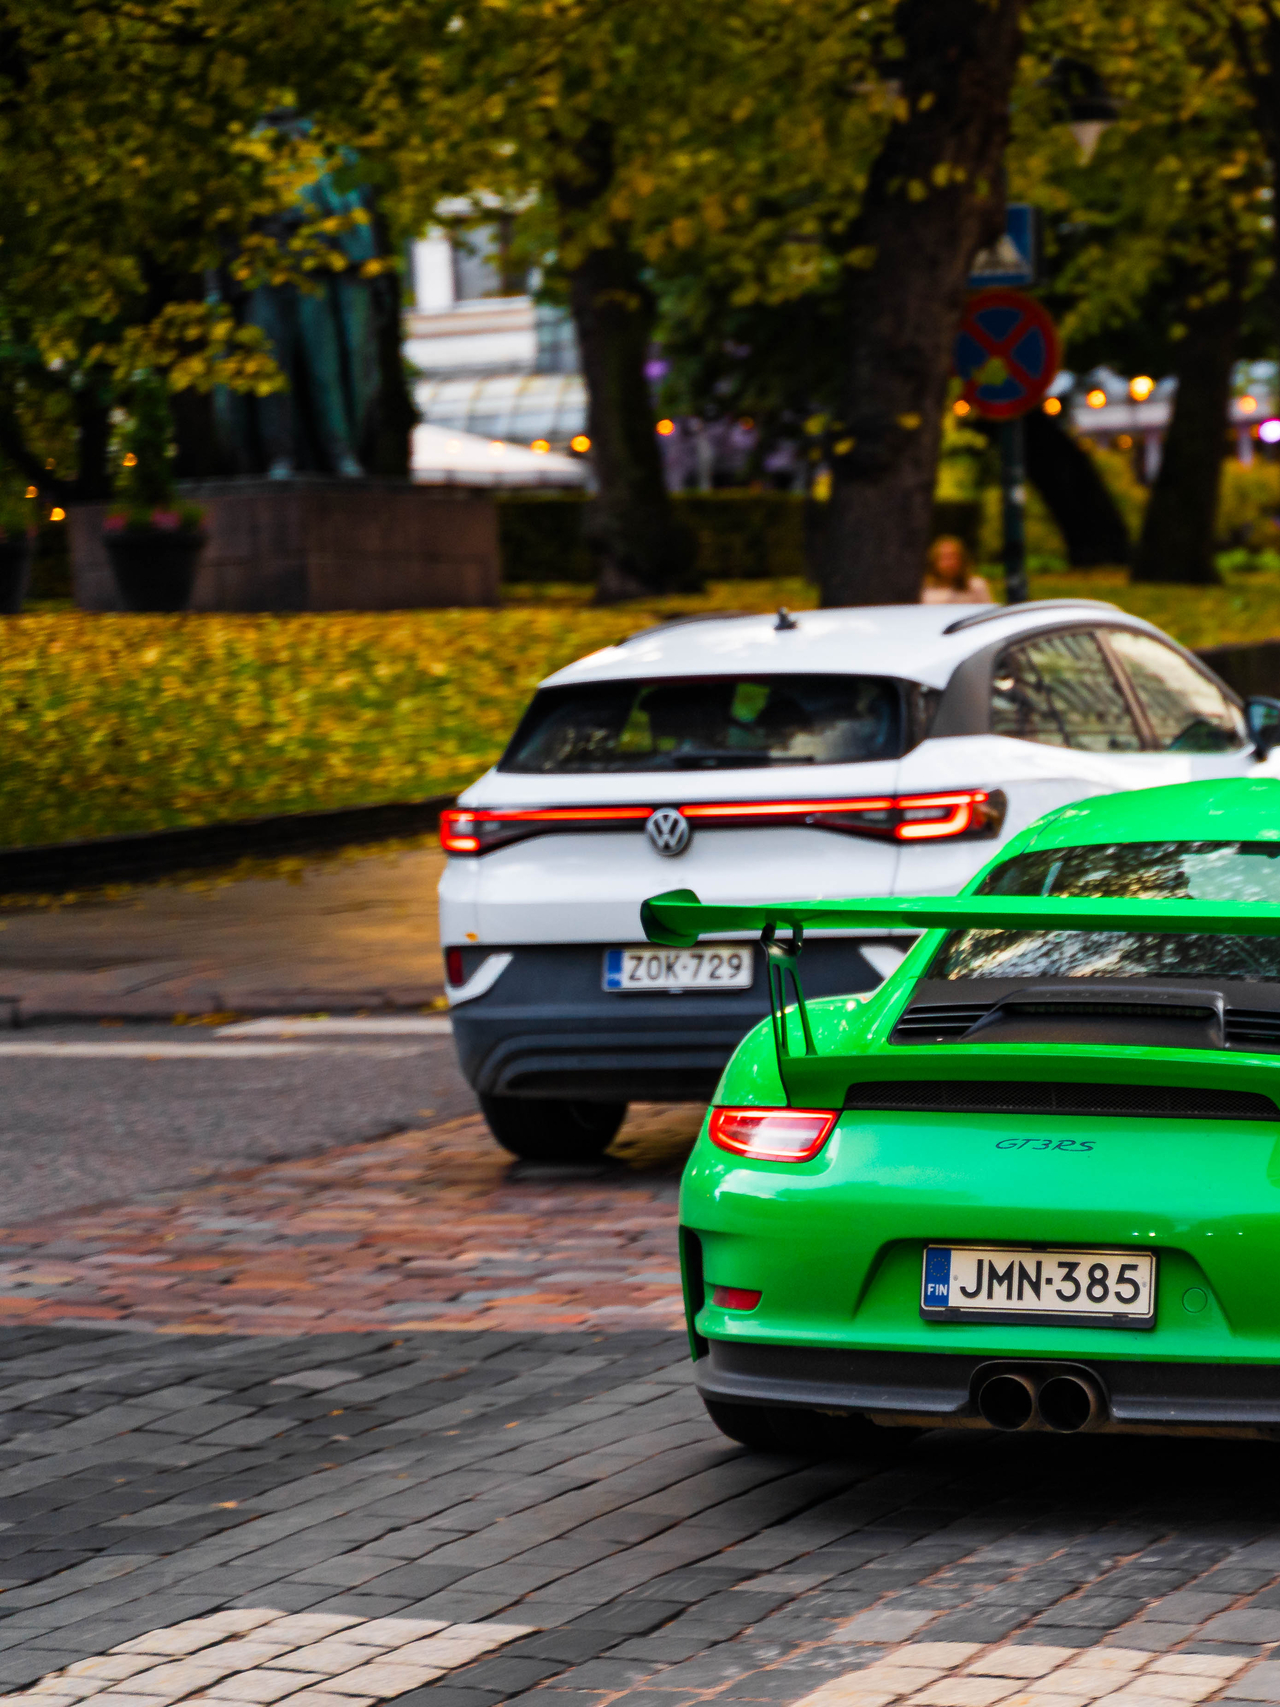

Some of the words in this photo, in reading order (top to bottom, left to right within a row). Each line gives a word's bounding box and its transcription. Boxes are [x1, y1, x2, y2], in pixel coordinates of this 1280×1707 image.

[628, 953, 743, 981] ZOK-729
[927, 1283, 948, 1297] FIN
[959, 1258, 1141, 1305] JMN-385
